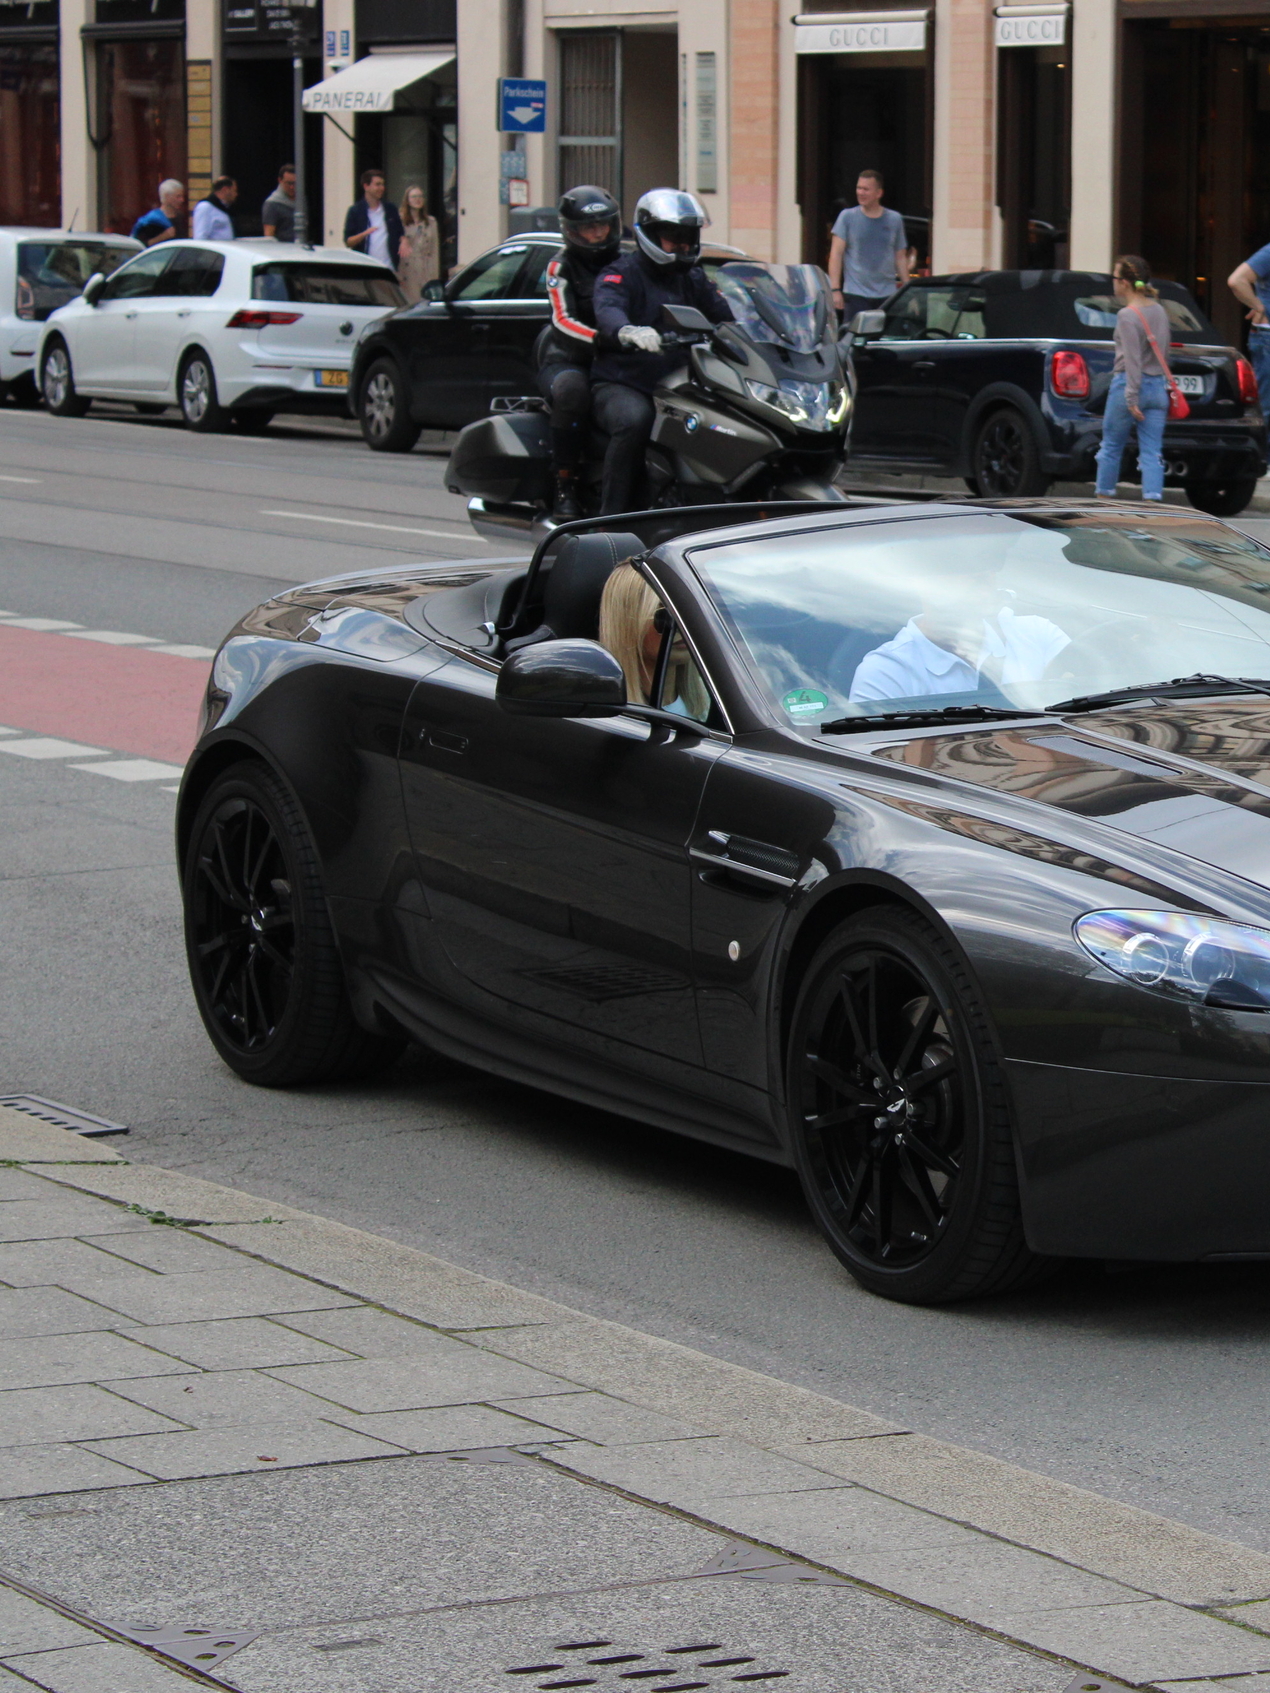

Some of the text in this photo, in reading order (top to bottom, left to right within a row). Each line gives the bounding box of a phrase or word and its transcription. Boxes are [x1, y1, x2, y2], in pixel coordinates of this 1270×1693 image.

[1000, 20, 1060, 40] GUCCI
[829, 27, 888, 47] GUCCI
[504, 86, 544, 98] Parkschein
[313, 92, 381, 109] PANERAI
[328, 372, 343, 384] ZG
[1183, 377, 1197, 390] 99
[799, 691, 812, 702] 4
